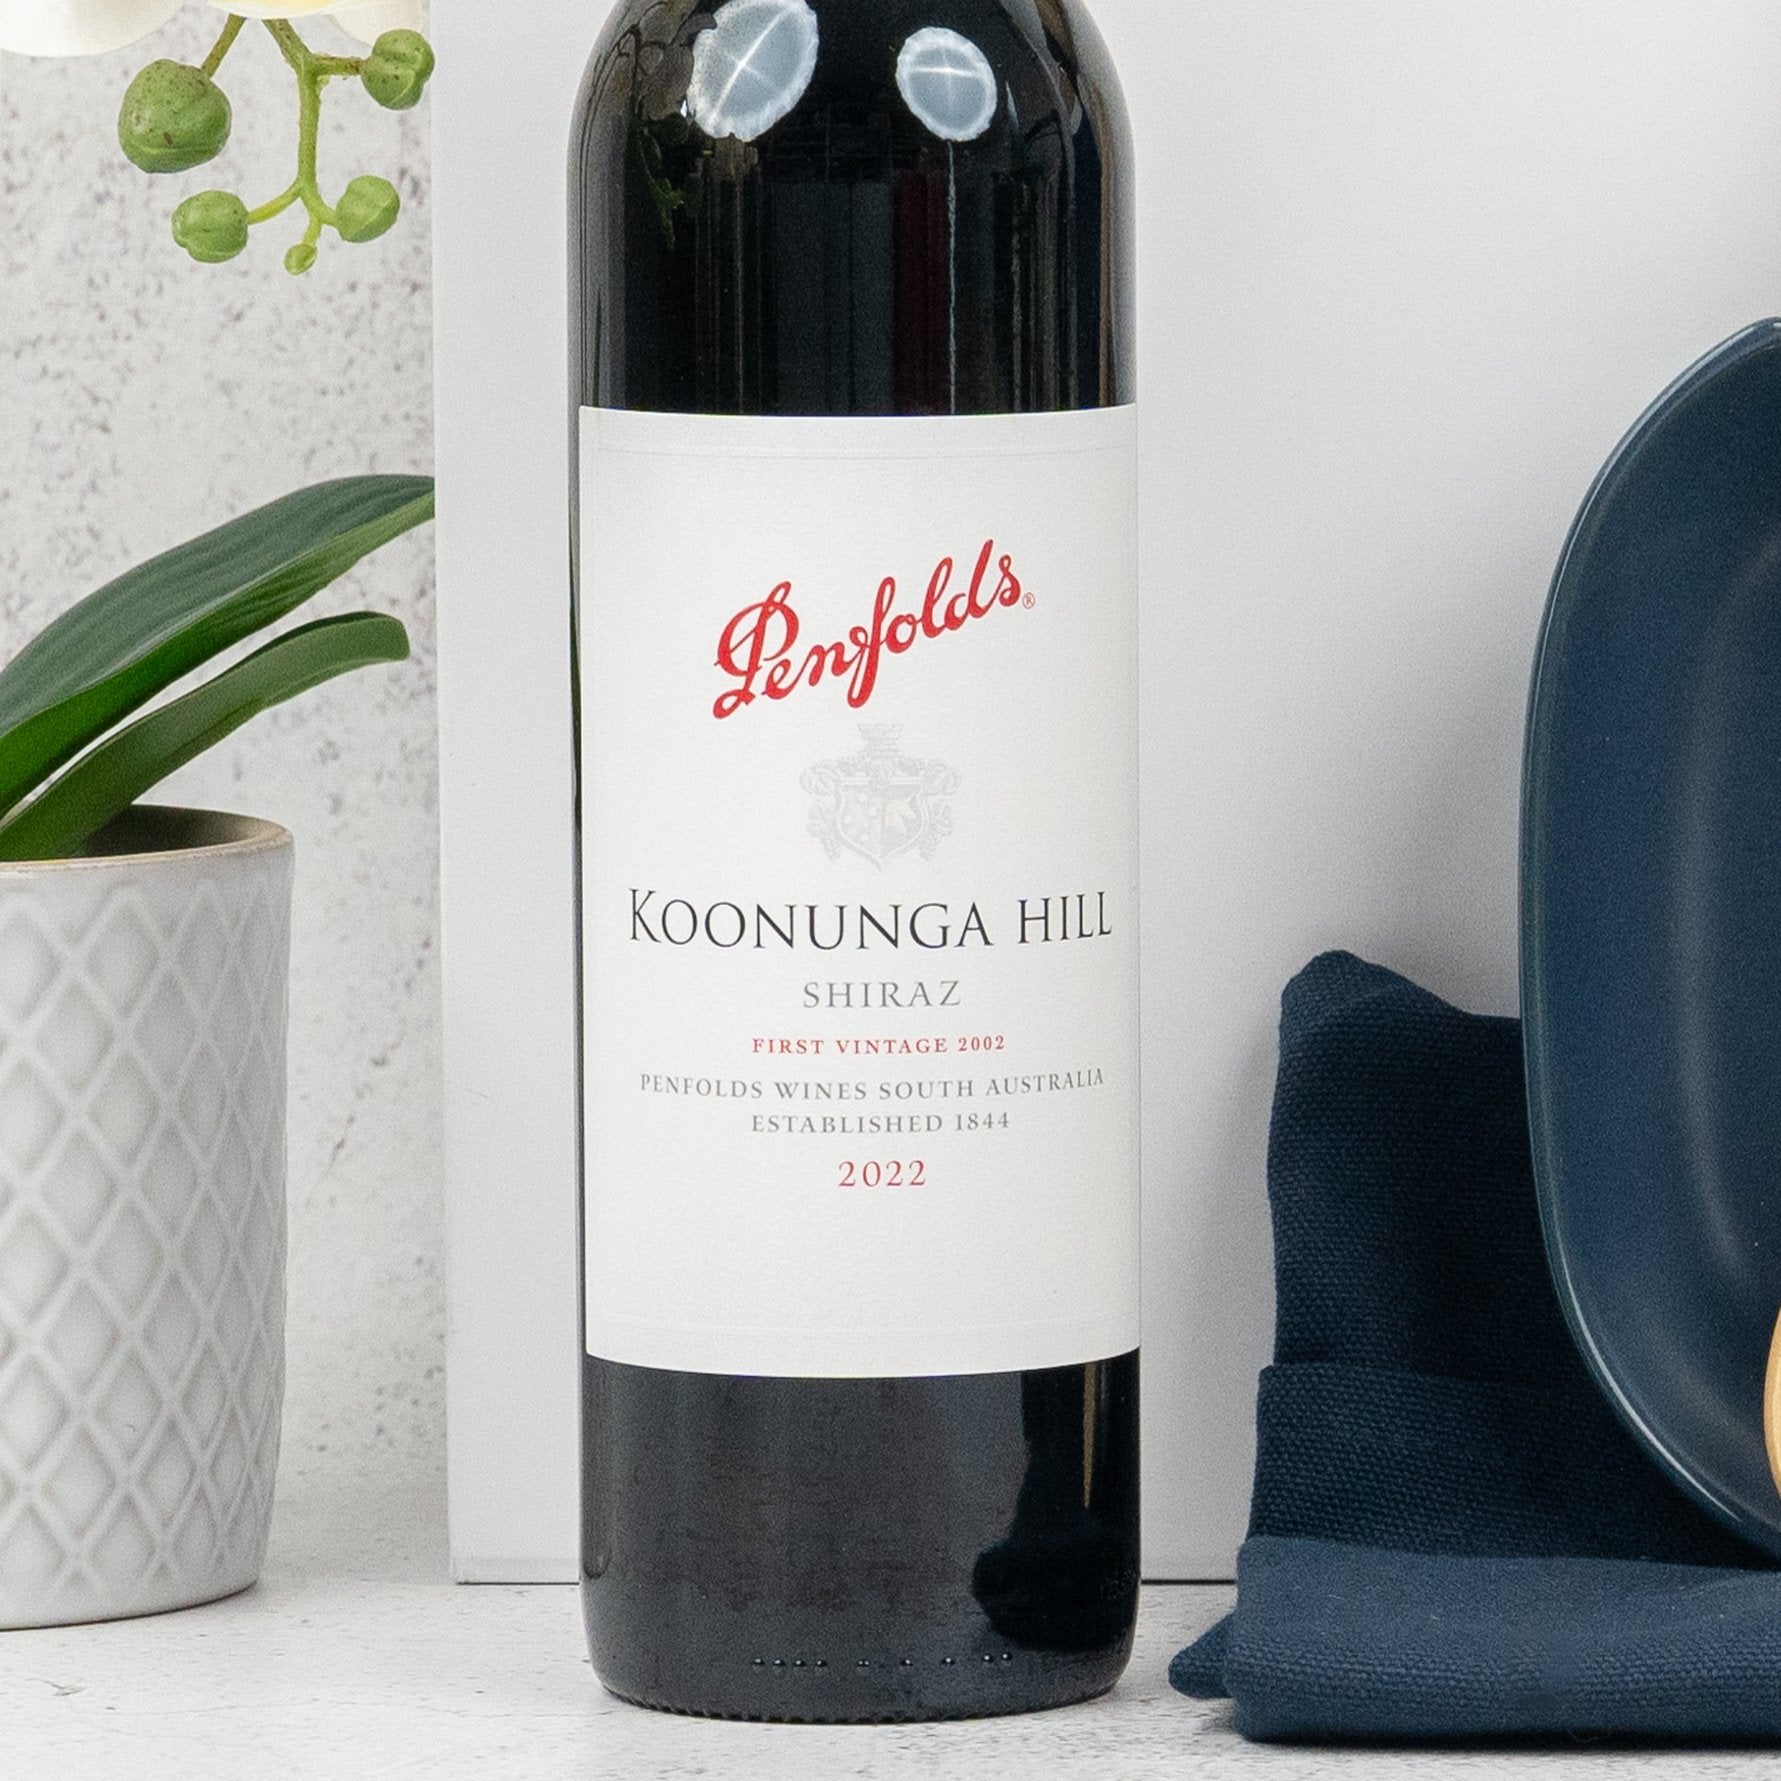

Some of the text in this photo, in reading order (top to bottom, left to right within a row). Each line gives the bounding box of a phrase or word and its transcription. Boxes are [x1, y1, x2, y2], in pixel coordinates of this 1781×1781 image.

[629, 888, 1112, 950] KOONUNGA HILL
[804, 980, 960, 1008] SHIRAZ
[753, 1035, 1004, 1054] FIRST VINTAGE 2002
[642, 1068, 1103, 1099] PENFOLDS WINES SOUTH AUSTRALIA
[753, 1112, 1008, 1133] ESTABLISHED 1844
[839, 1160, 925, 1187] 2022
